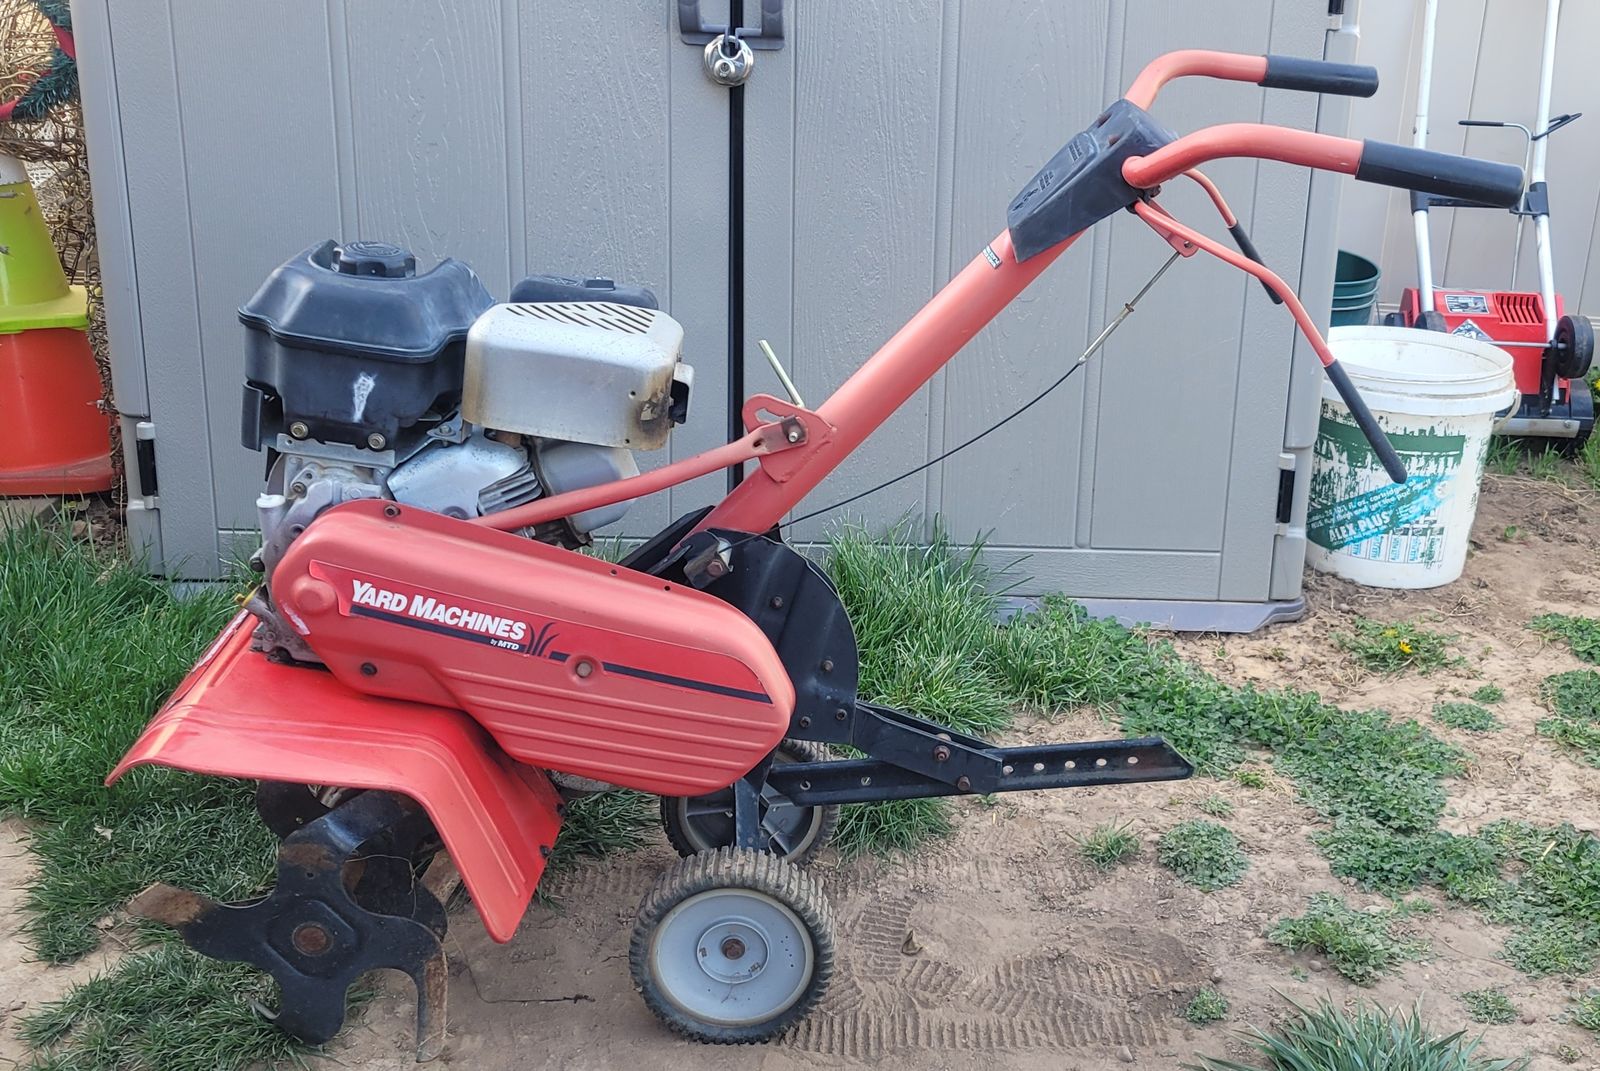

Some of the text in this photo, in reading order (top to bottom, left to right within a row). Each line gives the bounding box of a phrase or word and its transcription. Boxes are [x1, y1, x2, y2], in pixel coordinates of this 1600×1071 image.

[1329, 523, 1357, 542] ALEX
[1357, 511, 1391, 531] PLUS
[352, 579, 527, 640] YARD MACHINES
[490, 638, 519, 650] by MTD
